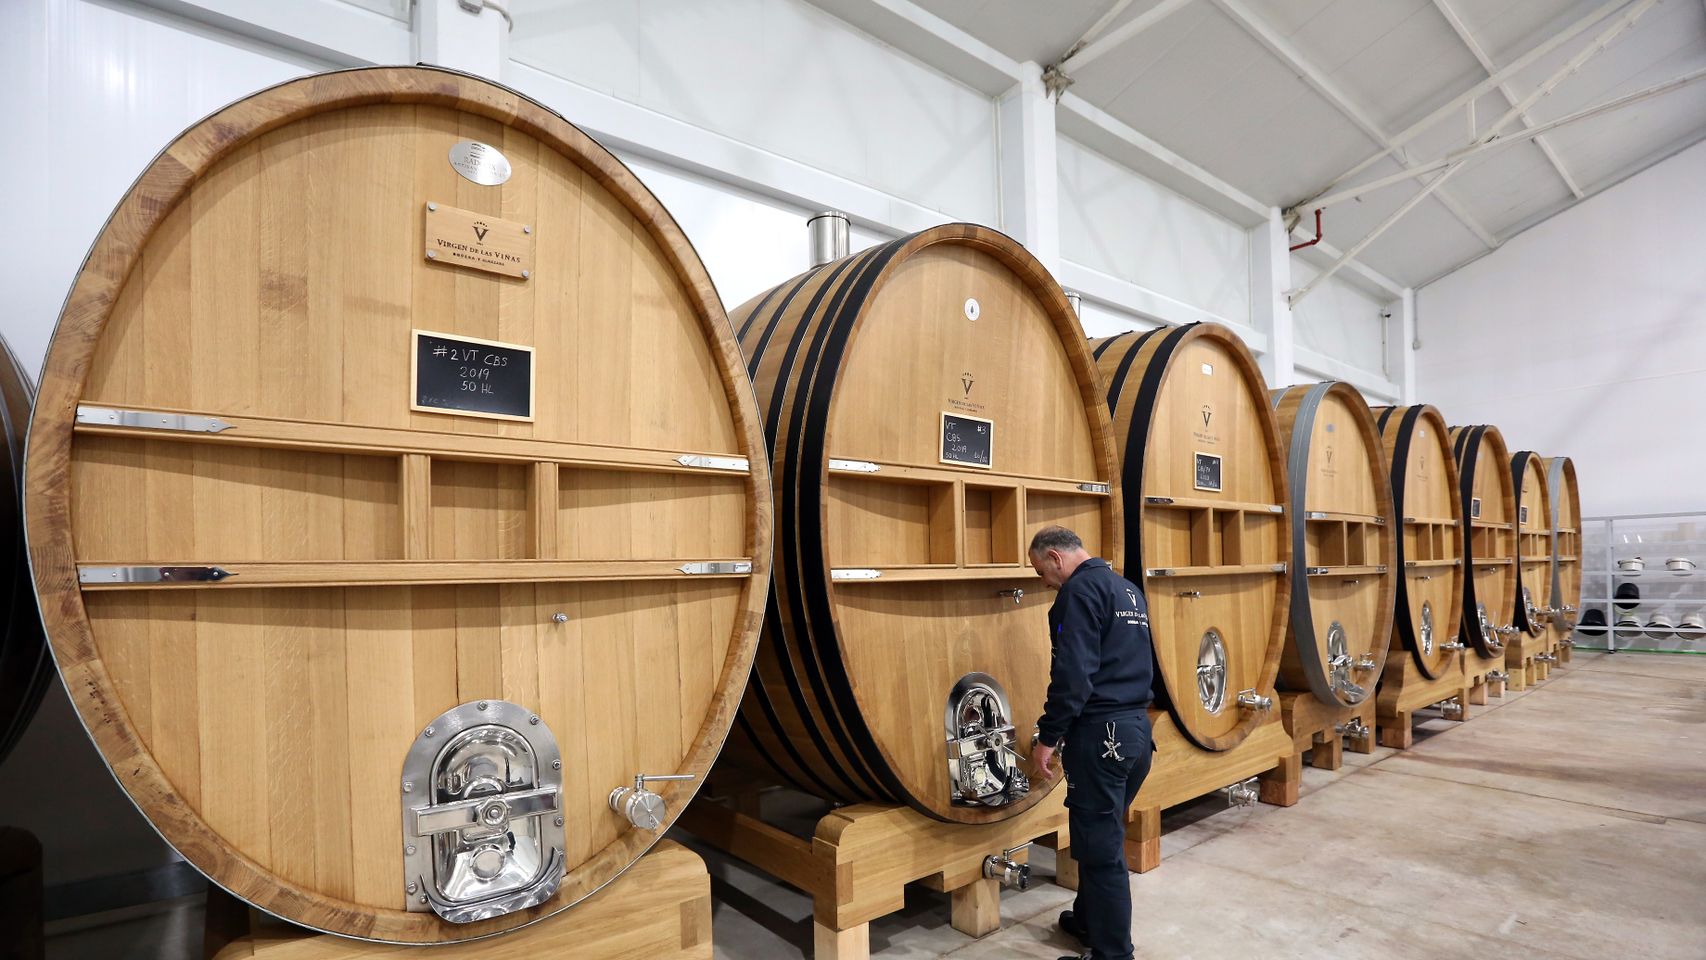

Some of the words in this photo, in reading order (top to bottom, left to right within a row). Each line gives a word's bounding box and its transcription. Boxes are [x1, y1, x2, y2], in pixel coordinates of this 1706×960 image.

[437, 239, 468, 252] VIRGEN
[483, 354, 508, 367] CBS
[459, 366, 490, 380] 2019
[460, 381, 477, 392] 50
